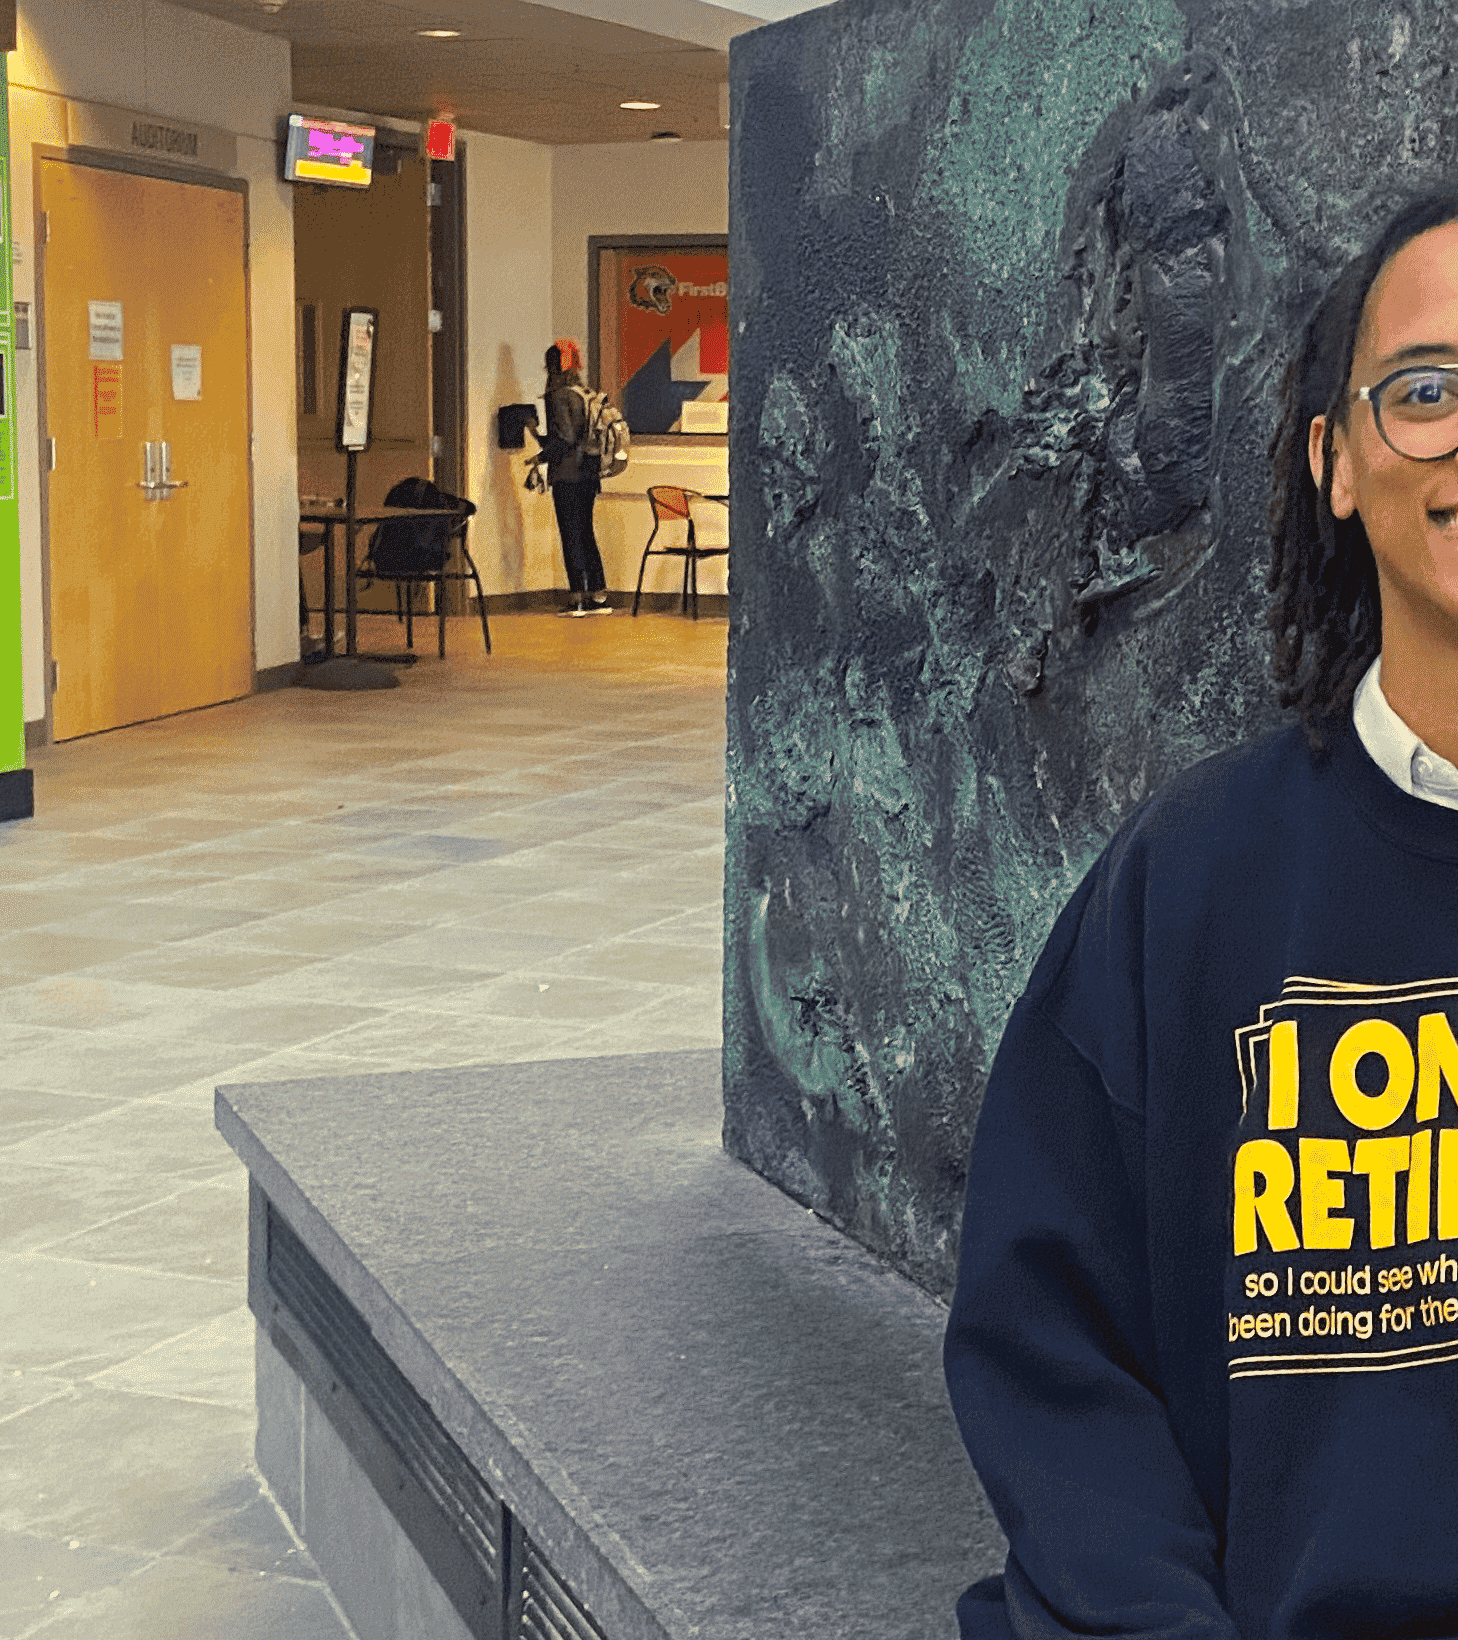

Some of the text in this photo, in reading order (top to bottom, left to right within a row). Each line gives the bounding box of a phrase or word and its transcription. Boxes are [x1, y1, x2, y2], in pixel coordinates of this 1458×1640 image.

[131, 121, 198, 157] AUDITORIUM
[1268, 1019, 1298, 1130] I
[1245, 1272, 1279, 1298] so
[1287, 1266, 1293, 1296] I
[1300, 1264, 1371, 1295] could
[1377, 1265, 1413, 1294] see
[1228, 1312, 1291, 1342] been
[1298, 1304, 1373, 1340] doing
[1379, 1303, 1415, 1334] for
[1420, 1295, 1458, 1327] the
